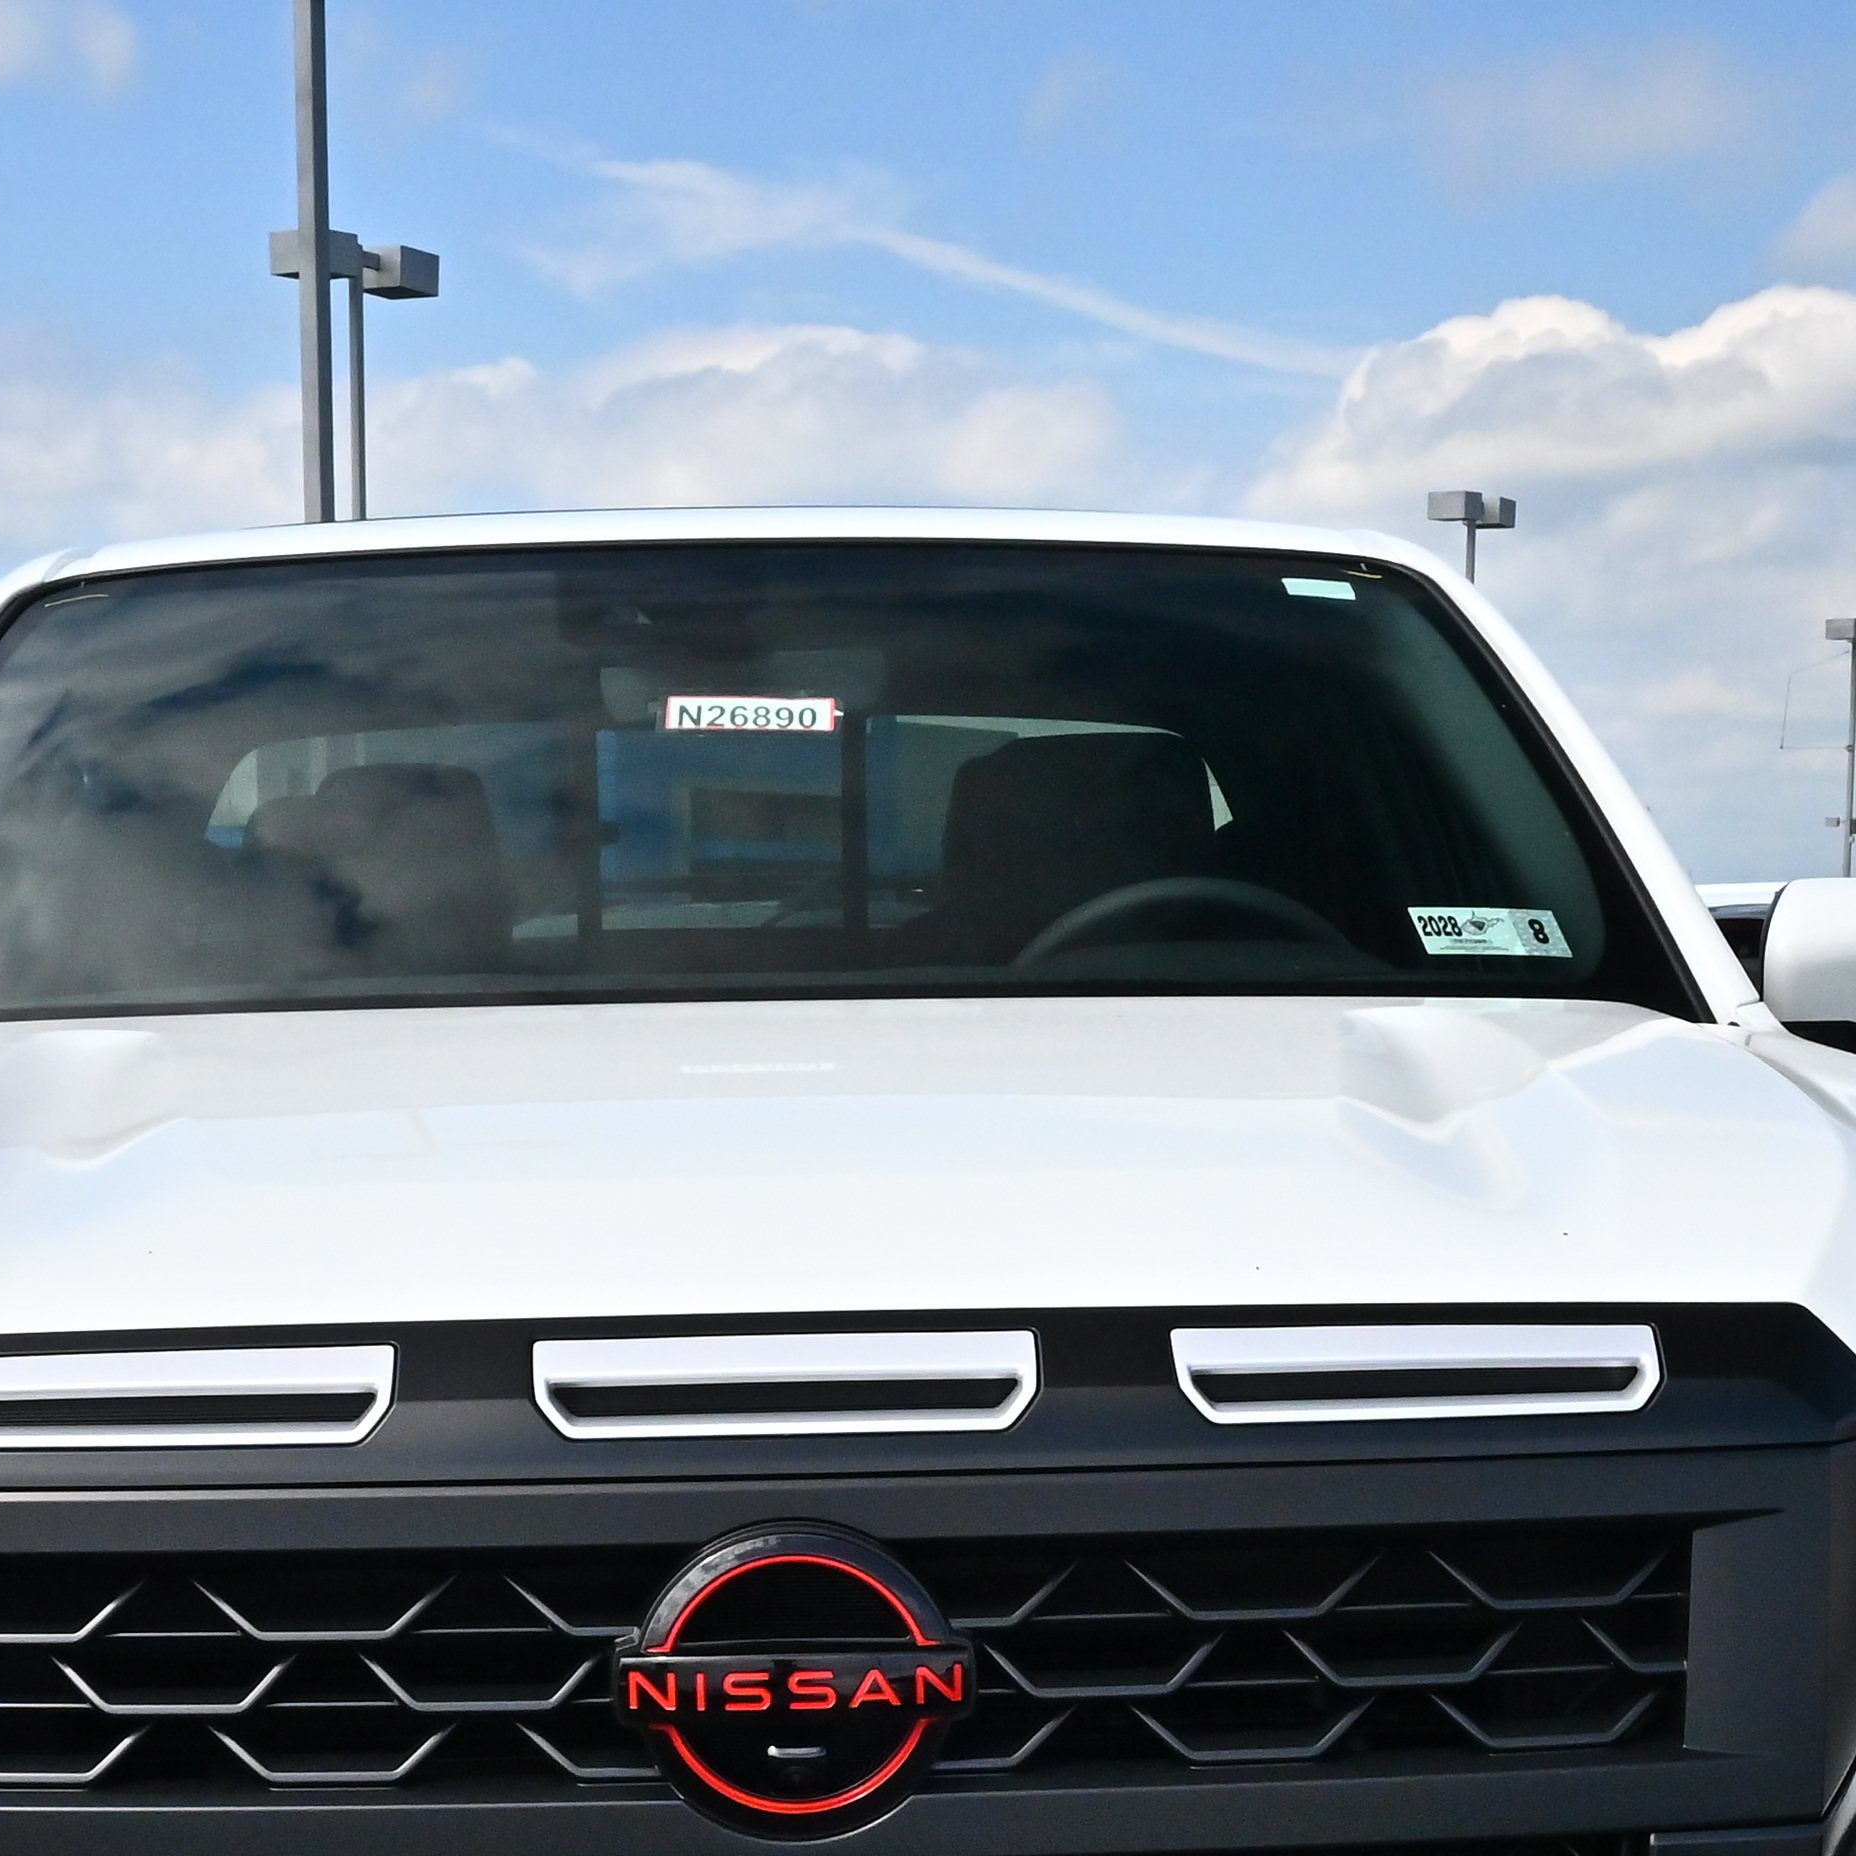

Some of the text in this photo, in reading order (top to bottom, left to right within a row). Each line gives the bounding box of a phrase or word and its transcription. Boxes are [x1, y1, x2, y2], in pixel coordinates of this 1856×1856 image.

[678, 705, 817, 728] N26890
[1418, 915, 1463, 937] 2028
[1528, 918, 1550, 944] 8
[628, 1663, 963, 1711] NISSAN
